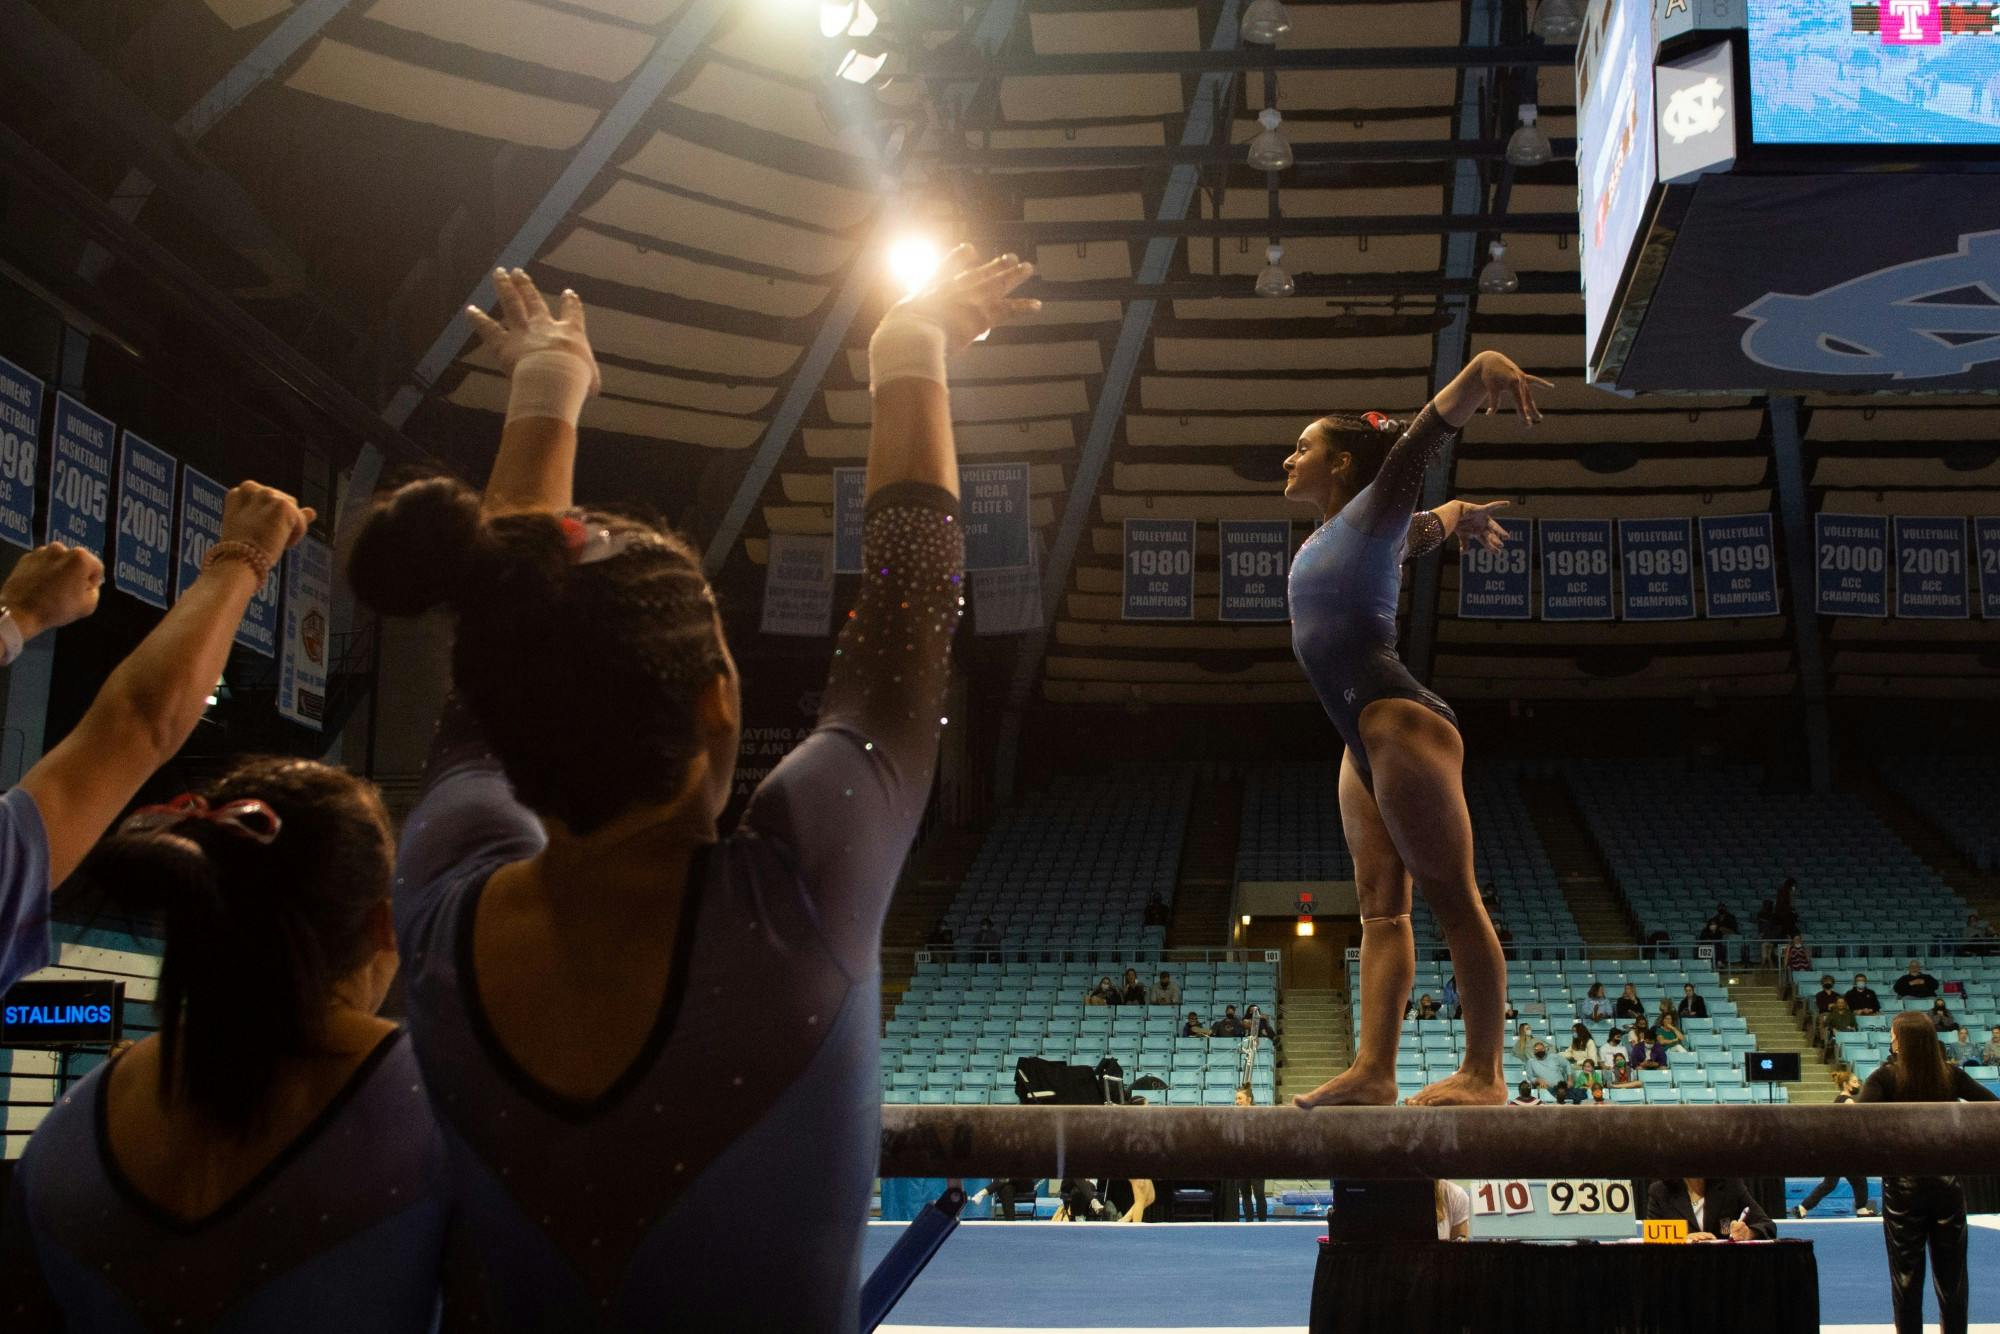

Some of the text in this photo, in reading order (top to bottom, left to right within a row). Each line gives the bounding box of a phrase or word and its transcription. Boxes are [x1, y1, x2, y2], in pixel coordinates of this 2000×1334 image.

[0, 376, 32, 407] OMENS
[67, 414, 104, 449] WOMENS
[0, 427, 35, 487] 98
[59, 435, 109, 476] BASKETBALL
[132, 450, 166, 483] WOMENS
[962, 469, 1022, 482] VOLLEYBALL
[54, 460, 107, 523] 2005
[126, 469, 169, 509] BASKETBALL
[975, 484, 1009, 498] NCAA
[971, 501, 1002, 514] ELITE
[69, 514, 87, 538] ACC
[121, 494, 169, 554] 2006
[1132, 531, 1188, 542] VOLLEYBALL
[1227, 532, 1283, 544] VOLLEYBALL
[1547, 531, 1604, 543] VOLLEYBALL
[1627, 530, 1684, 542] VOLLEYBALL
[1708, 526, 1764, 540] VOLLEYBALL
[1823, 526, 1880, 539] VOLLEYBALL
[1903, 528, 1959, 540] VOLLEYBALL
[184, 527, 214, 570] 20
[136, 545, 152, 567] ACC
[1129, 550, 1190, 576] 1980
[1467, 549, 1526, 574] 1983
[1546, 550, 1608, 576] 1988
[1625, 549, 1688, 576] 1989
[1707, 544, 1771, 573] 1999
[1820, 544, 1883, 573] 2000
[1902, 548, 1961, 575] 2001
[1227, 551, 1284, 577] 1981
[119, 561, 165, 597] CHAMPIONS
[1485, 579, 1505, 591] ACC
[1731, 578, 1752, 590] ACC
[1841, 577, 1862, 589] ACC
[1921, 580, 1942, 592] ACC
[1149, 582, 1168, 593] ACC
[1245, 583, 1265, 594] ACC
[1567, 582, 1588, 593] ACC
[1648, 581, 1668, 593] ACC
[1130, 595, 1187, 607] CHAMPIONS
[1226, 597, 1284, 608] CHAMPIONS
[1466, 593, 1525, 606] CHAMPIONS
[1548, 596, 1608, 608] CHAMPIONS
[1630, 595, 1688, 608] CHAMPIONS
[1712, 591, 1772, 605] CHAMPIONS
[1822, 591, 1881, 604] CHAMPIONS
[1903, 594, 1962, 606] CHAMPIONS
[1267, 952, 1278, 961] 101
[1347, 950, 1360, 959] 102
[5, 1005, 111, 1024] STALLINGS
[1478, 1181, 1631, 1213] 10 930
[1647, 1224, 1683, 1240] UTL
